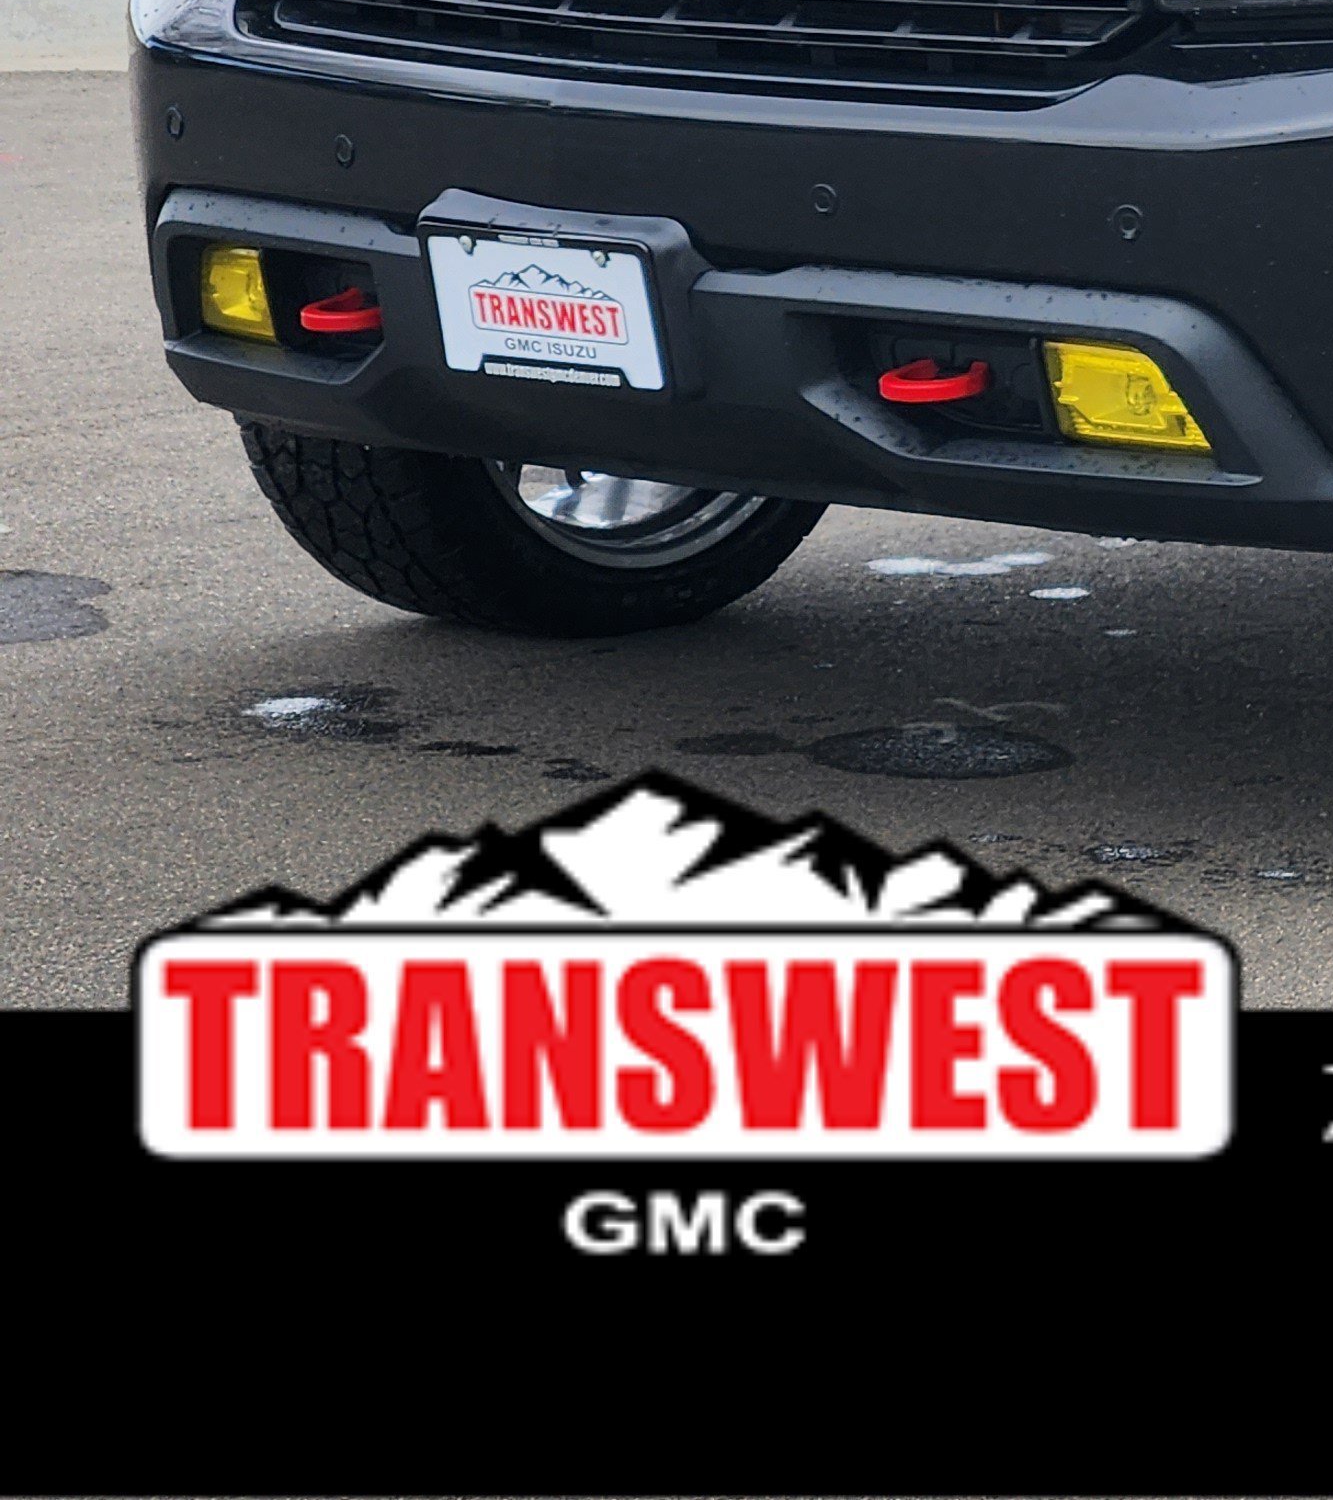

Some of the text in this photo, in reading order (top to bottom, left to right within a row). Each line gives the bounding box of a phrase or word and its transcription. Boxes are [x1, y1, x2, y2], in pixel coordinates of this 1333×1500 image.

[473, 291, 621, 338] TRANSWEST
[504, 337, 597, 359] GMC ISUZU
